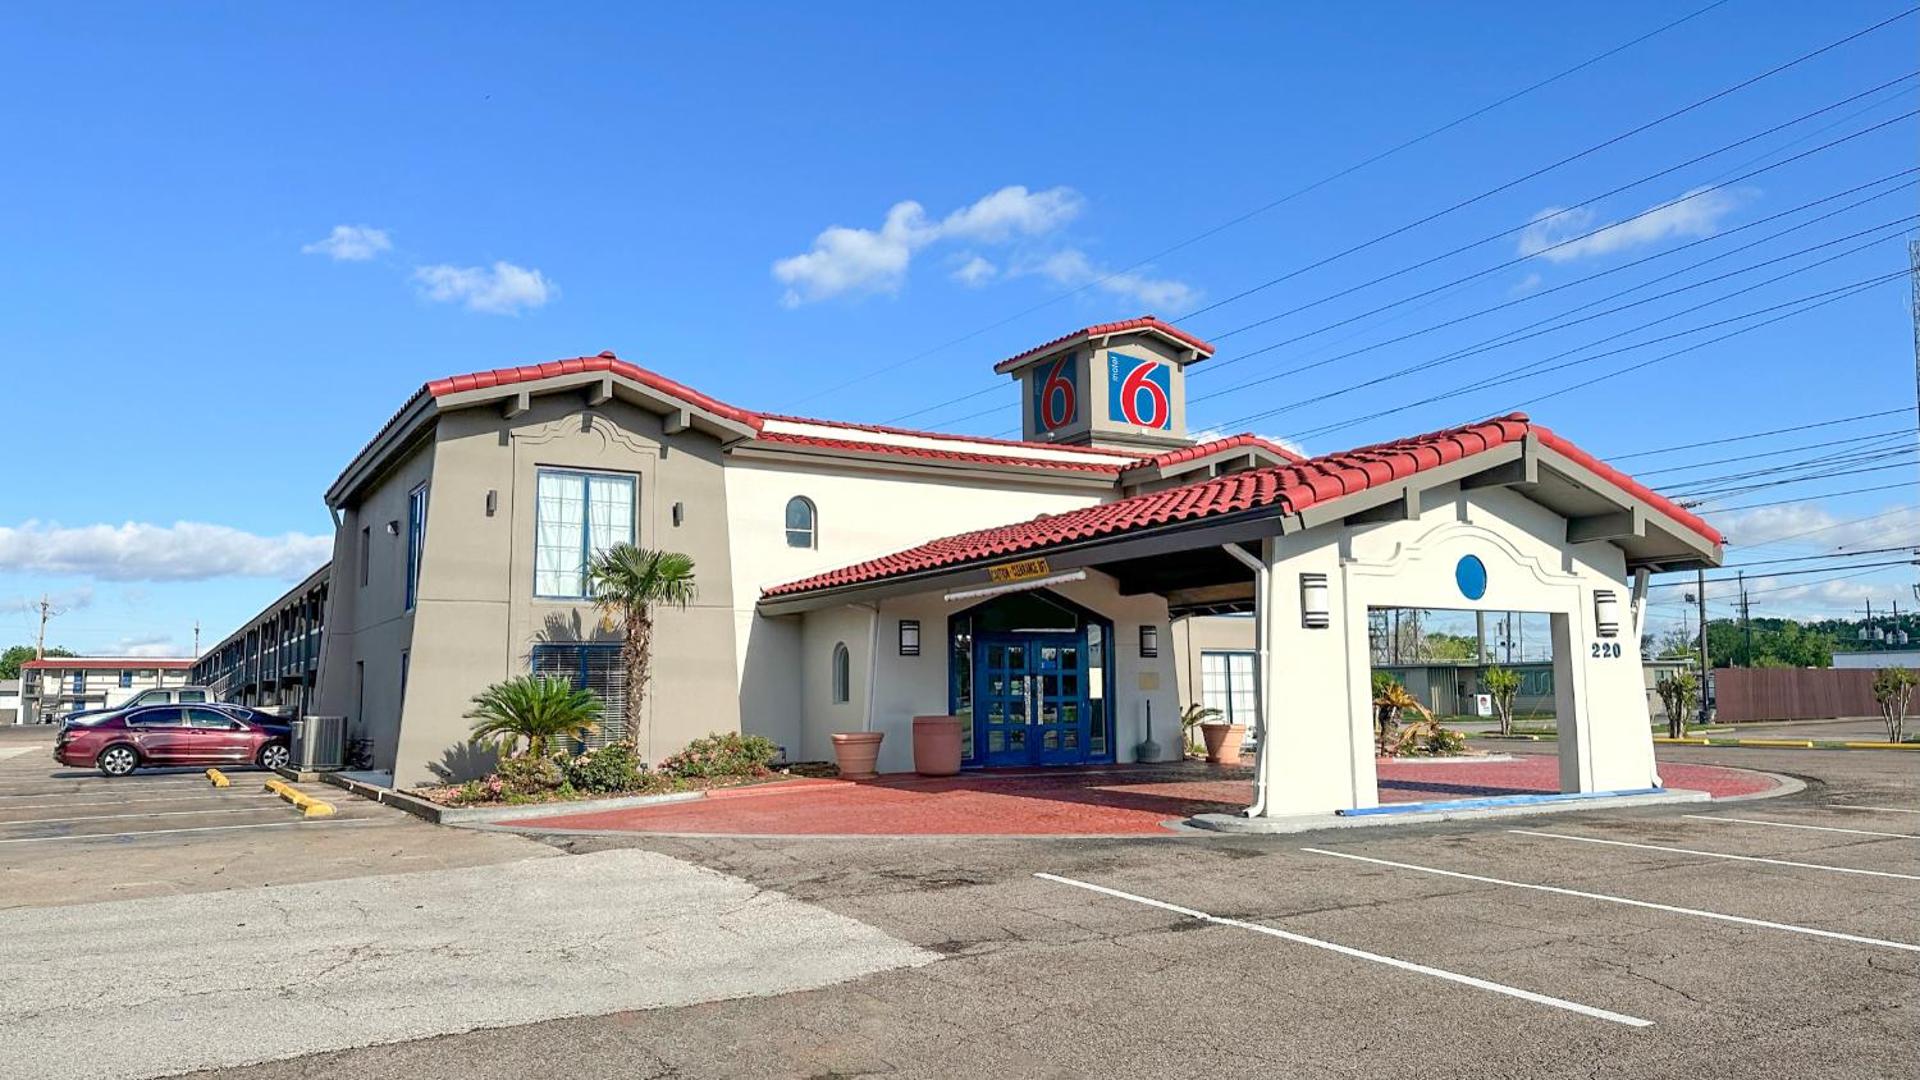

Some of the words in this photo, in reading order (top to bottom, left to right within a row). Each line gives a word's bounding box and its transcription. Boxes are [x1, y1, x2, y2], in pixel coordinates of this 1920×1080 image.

[1041, 354, 1075, 431] 6
[1120, 360, 1169, 429] 6
[1592, 643, 1621, 658] 220
